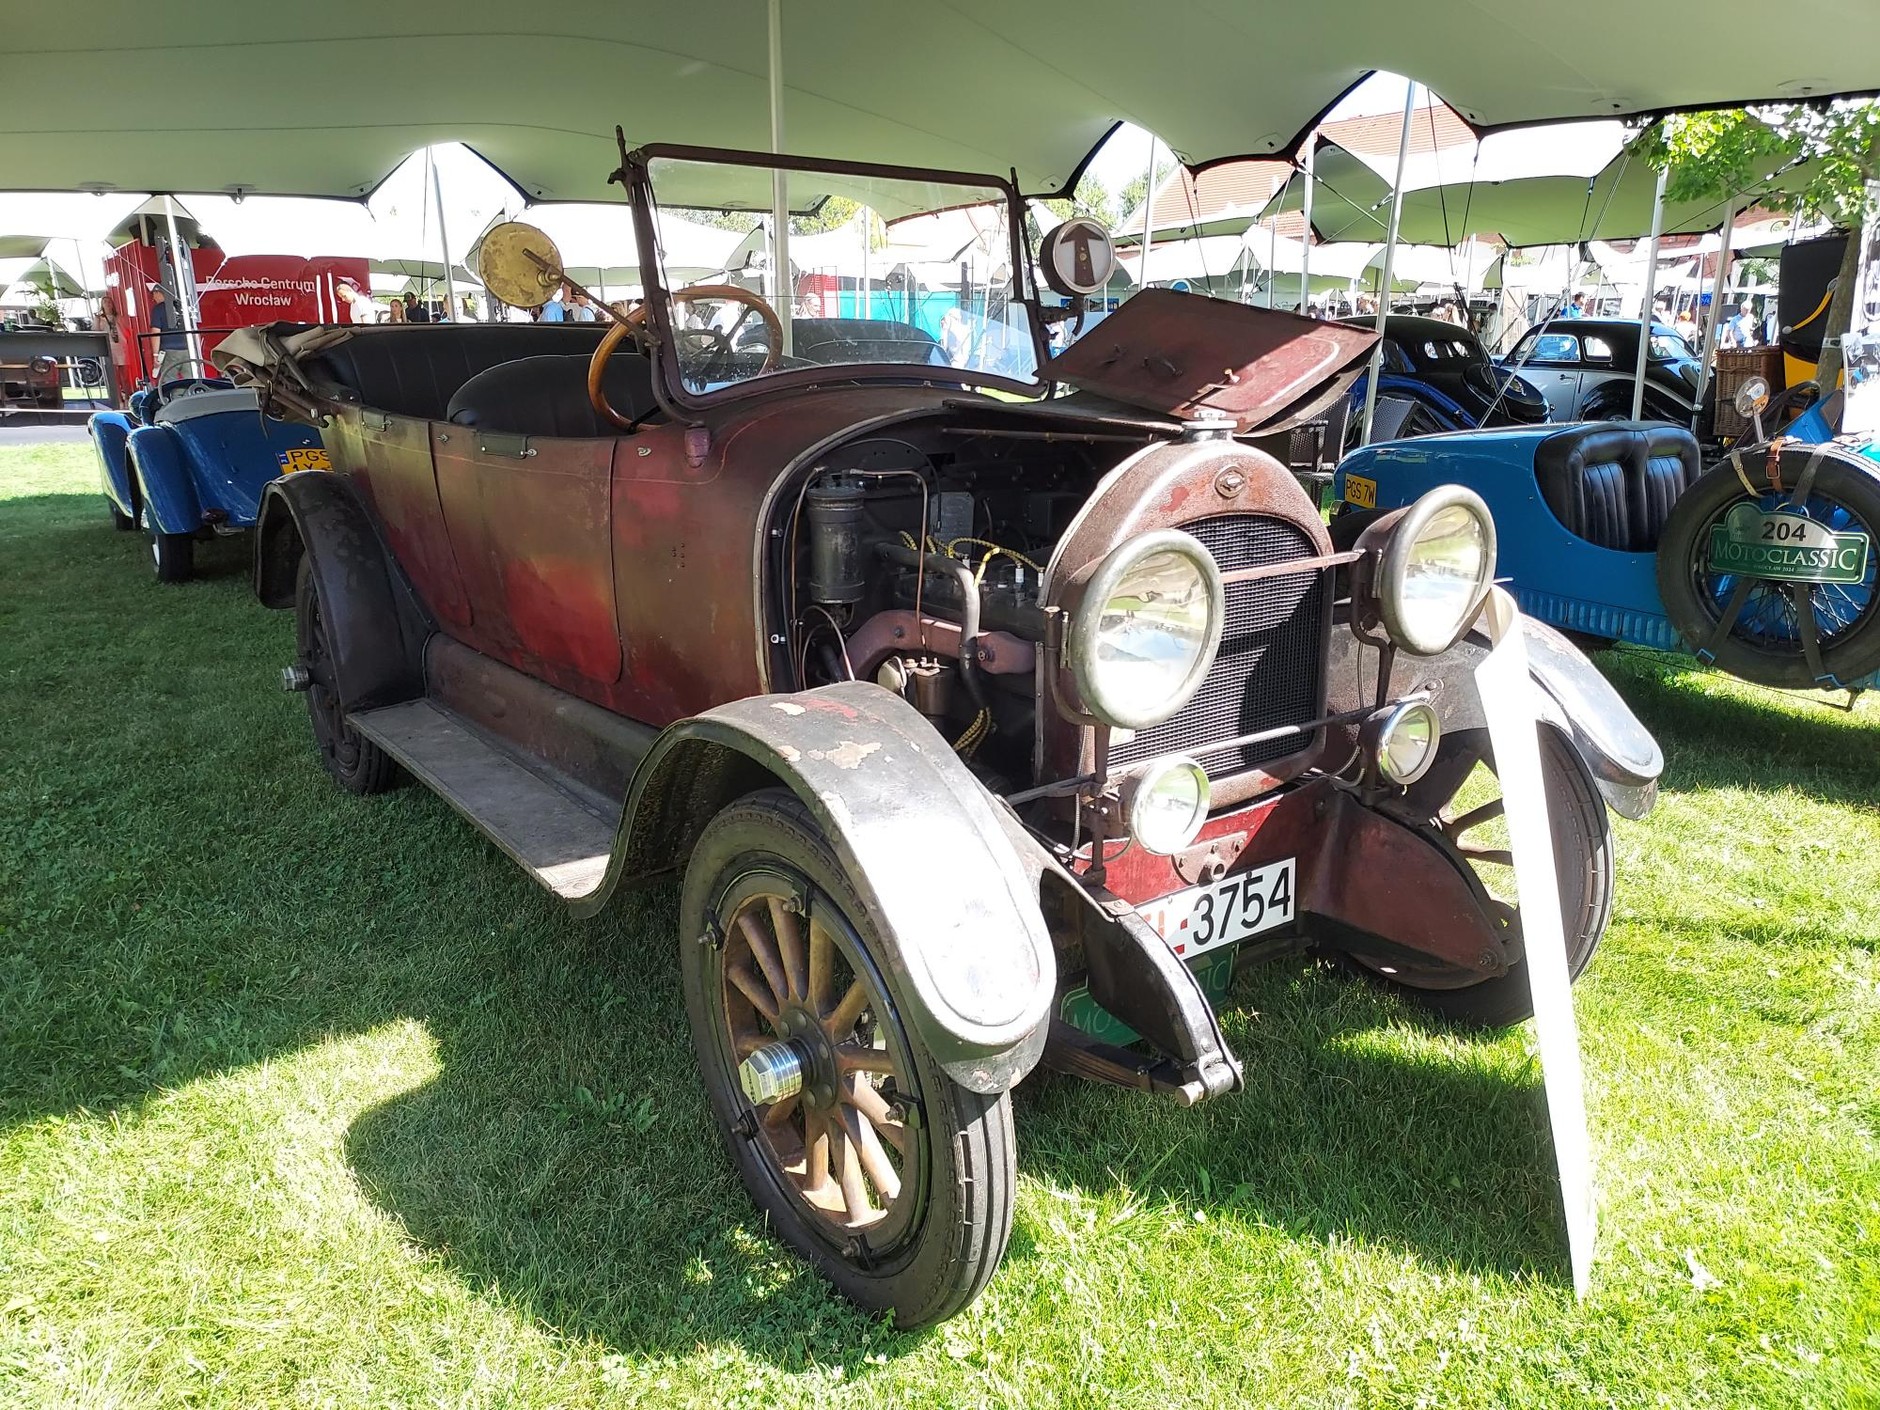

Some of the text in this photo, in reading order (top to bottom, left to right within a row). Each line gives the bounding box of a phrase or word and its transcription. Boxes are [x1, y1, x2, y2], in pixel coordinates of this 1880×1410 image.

[260, 277, 315, 292] Centrum
[234, 293, 291, 306] Wrocław
[1345, 478, 1362, 500] PGS
[1761, 521, 1807, 542] 204
[1713, 539, 1858, 571] MOTOCLASSIC
